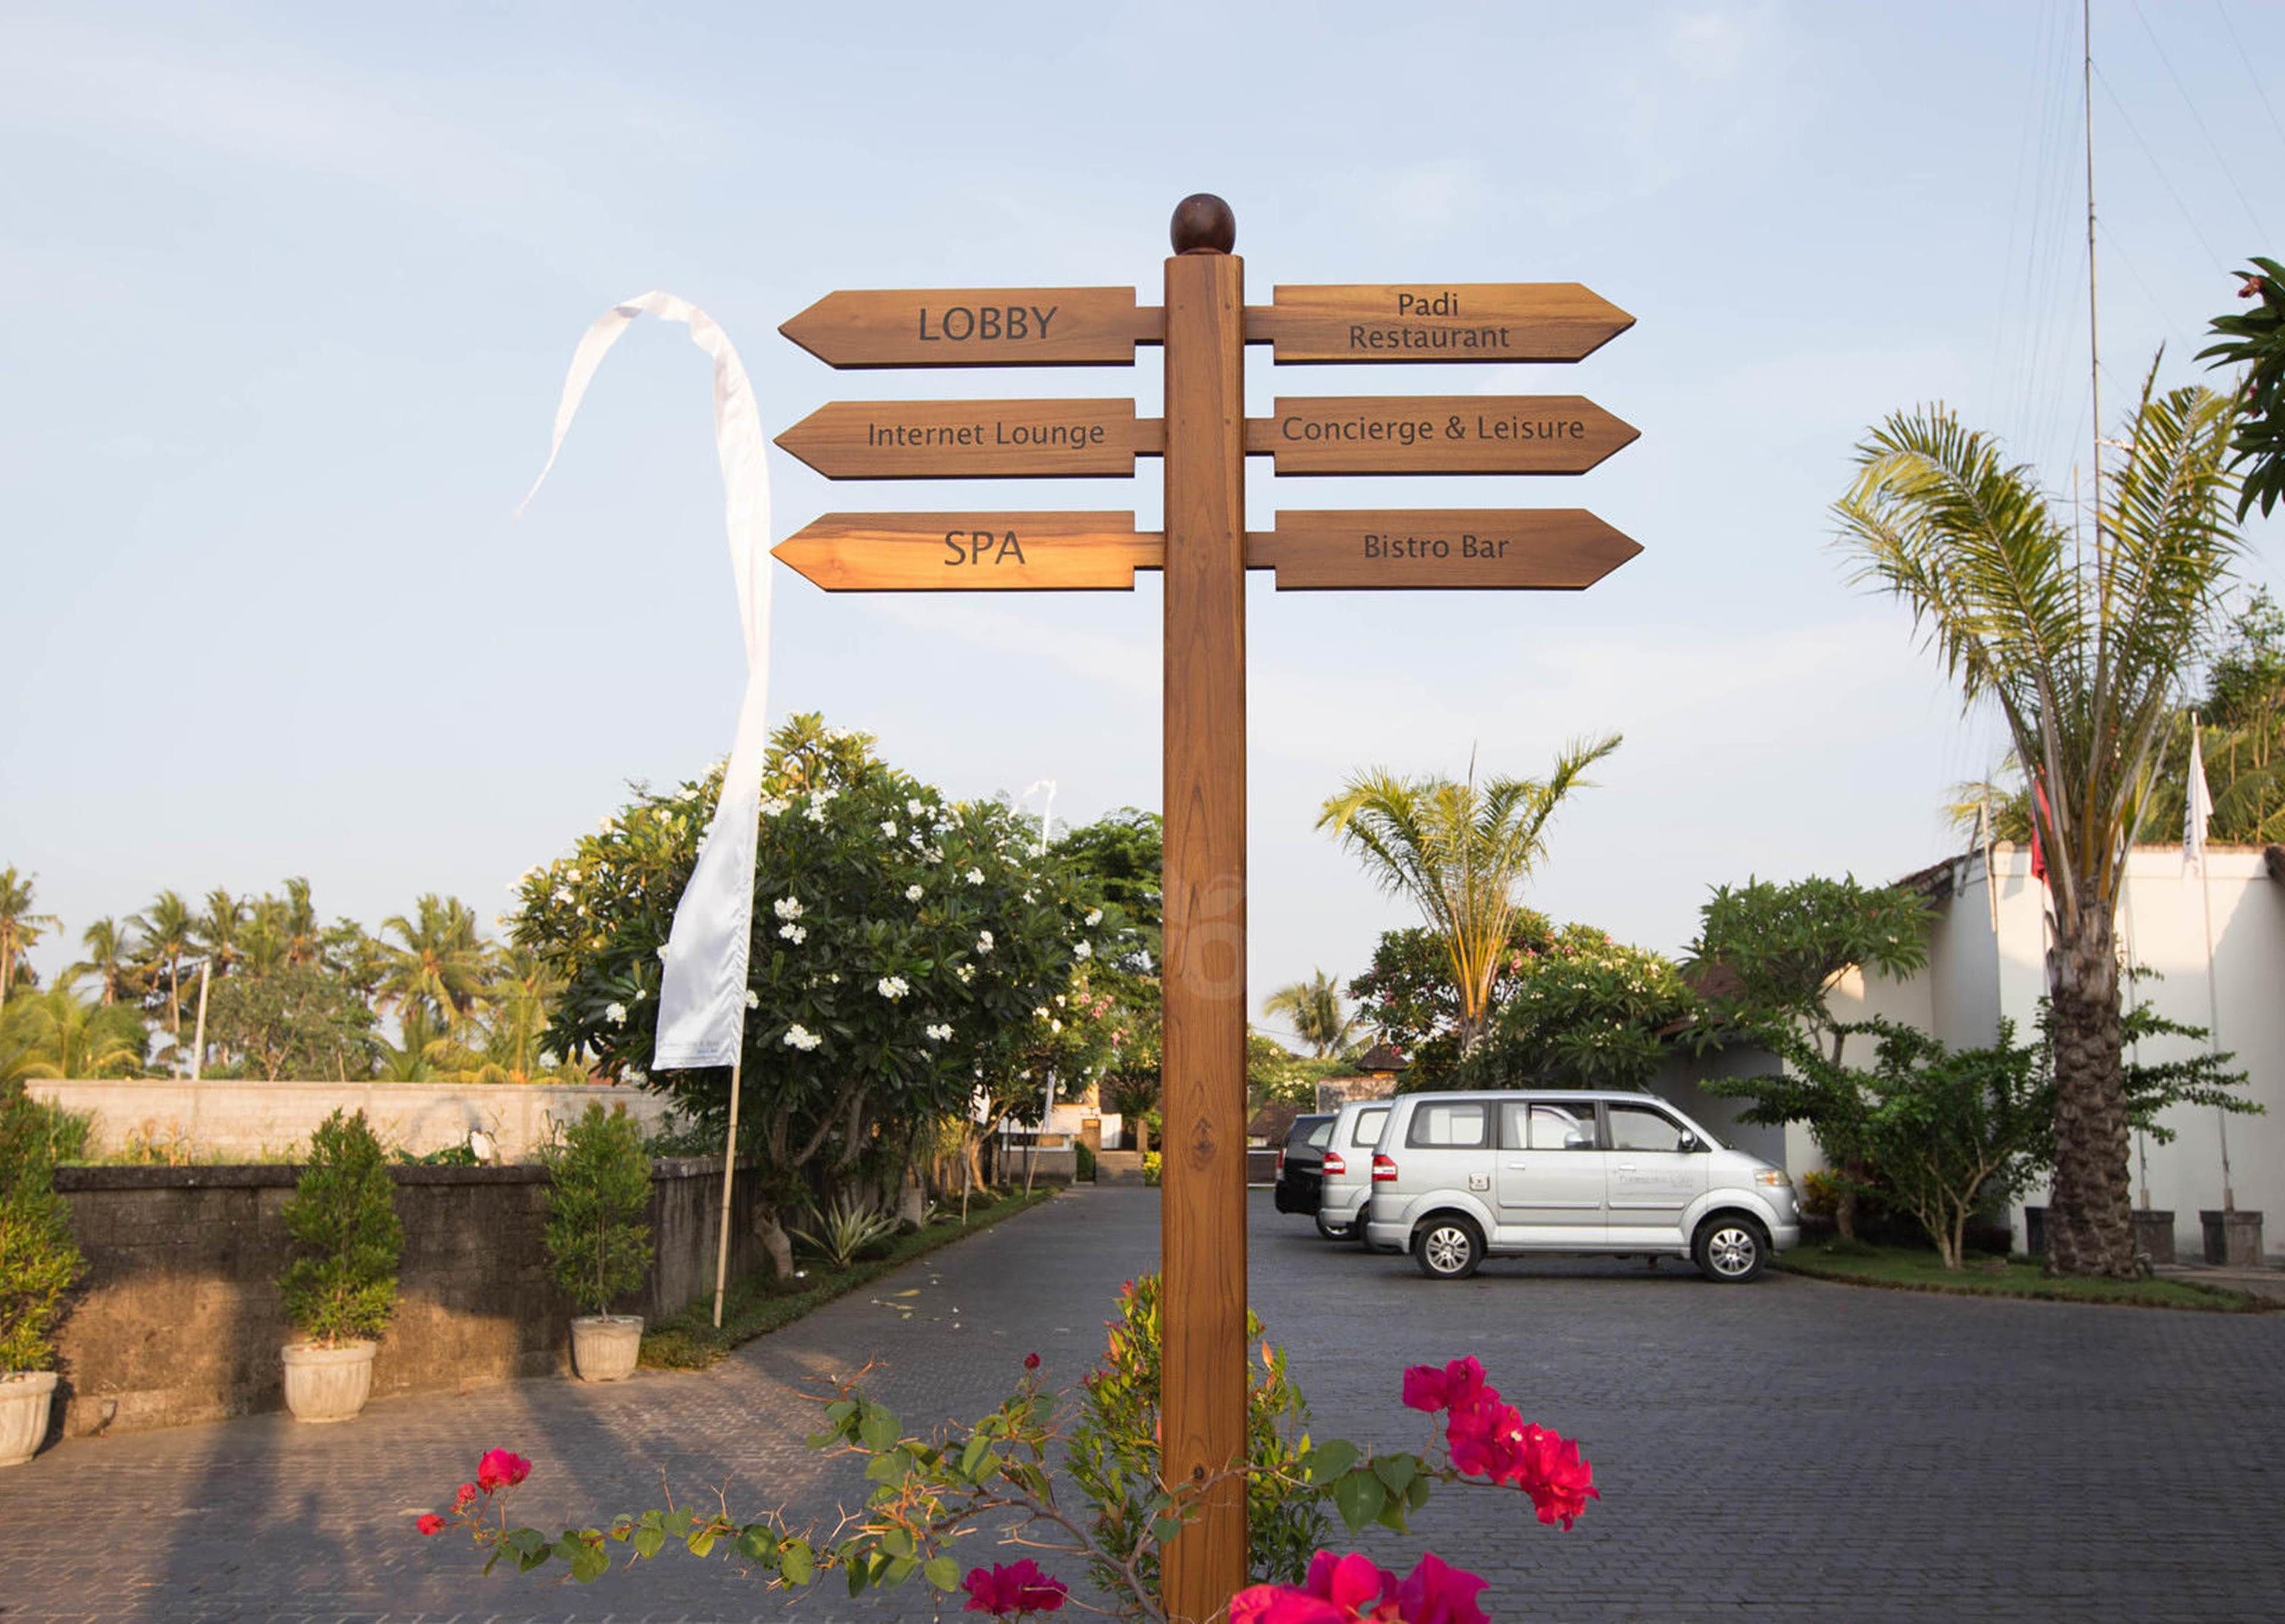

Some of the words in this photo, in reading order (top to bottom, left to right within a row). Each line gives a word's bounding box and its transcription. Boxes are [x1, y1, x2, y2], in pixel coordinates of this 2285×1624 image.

[1398, 292, 1459, 317] Padi
[919, 306, 1058, 341] LOBBY
[1350, 326, 1510, 349] Restaurant
[869, 423, 984, 446] Internet
[996, 421, 1105, 450] Lounge
[1282, 416, 1433, 445] Concierge
[1445, 416, 1466, 440] &
[1478, 416, 1585, 440] Leisure
[944, 530, 1026, 566] SPA
[1364, 534, 1449, 558] Bistro
[1462, 535, 1510, 558] Bar
